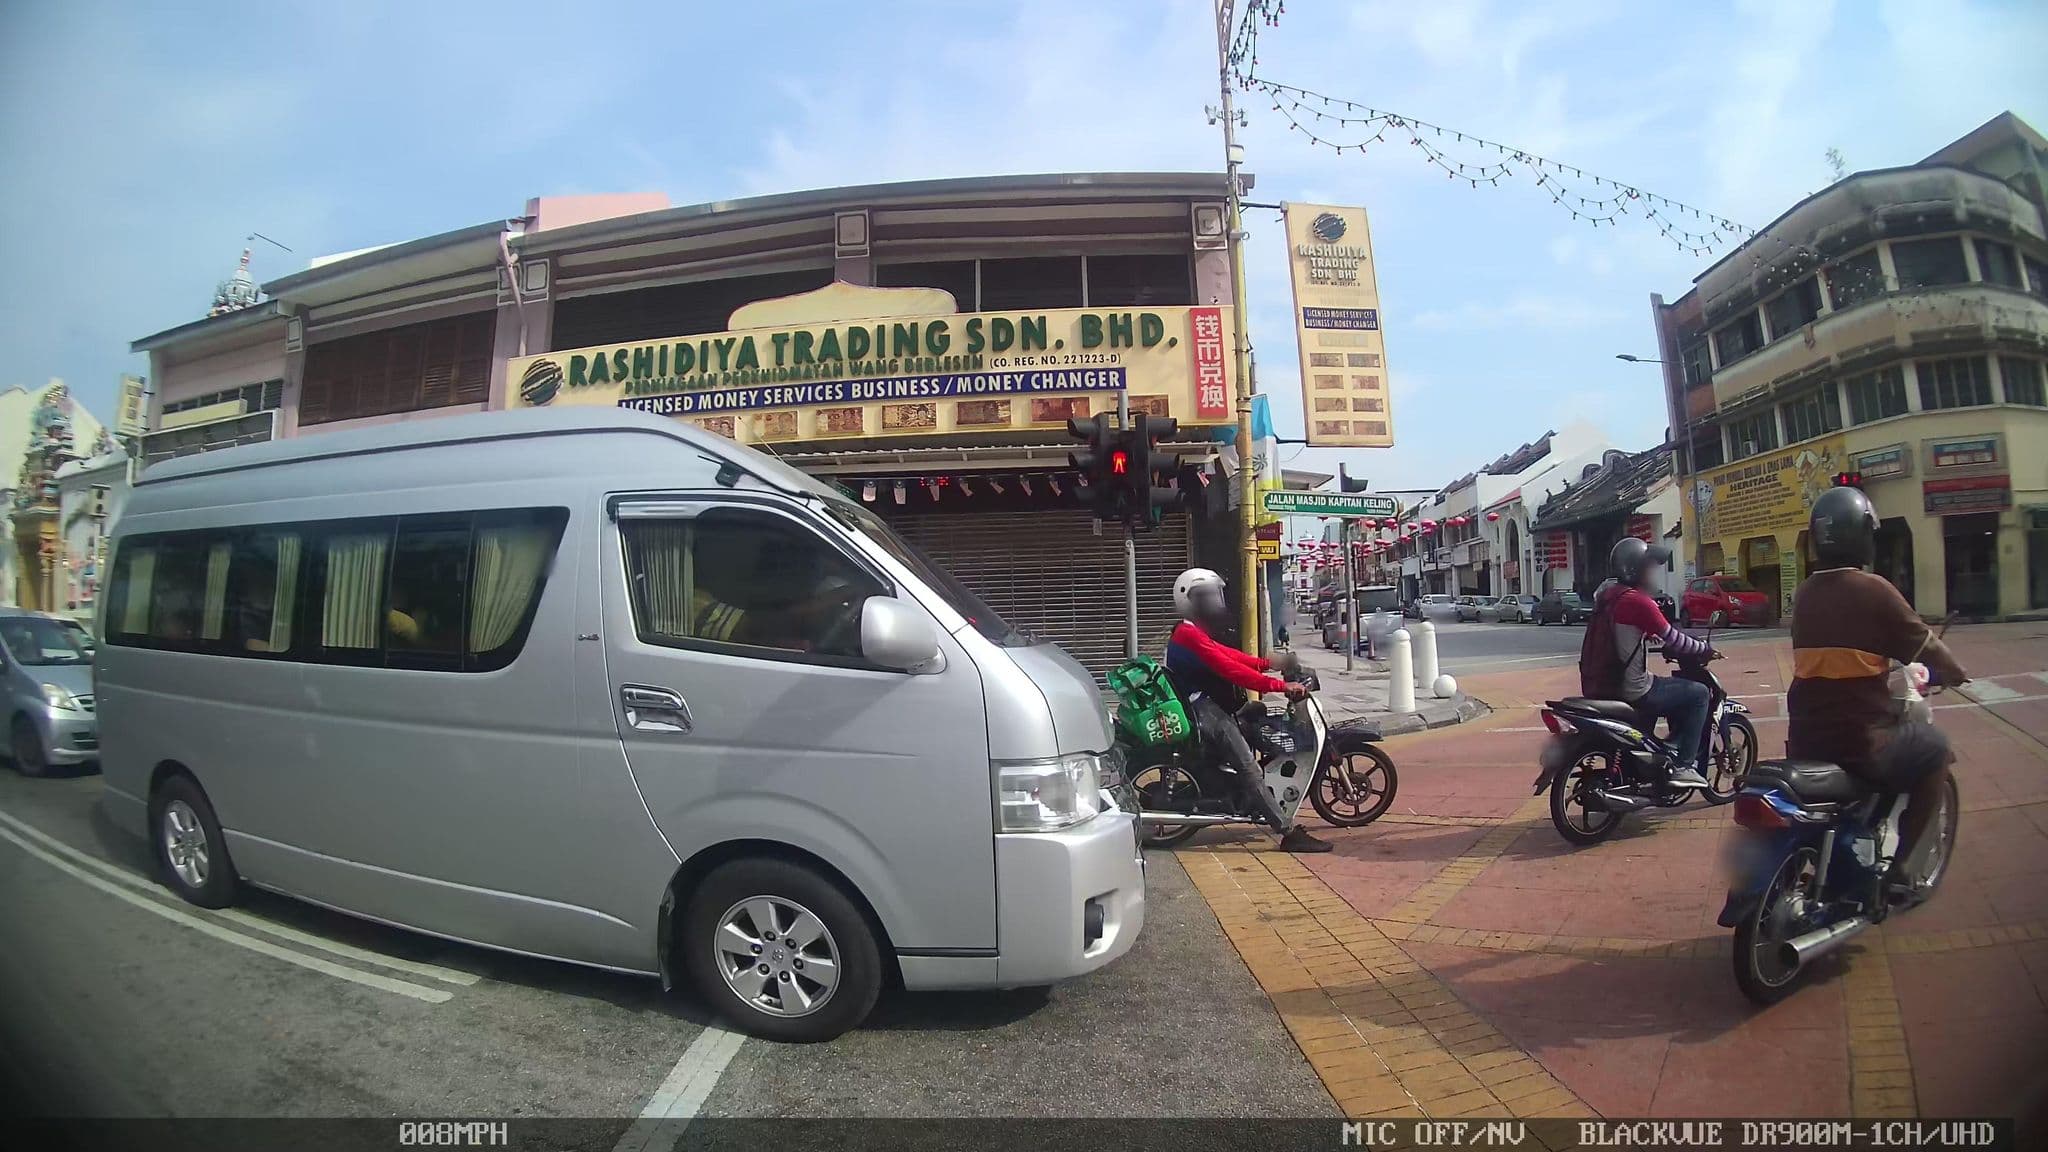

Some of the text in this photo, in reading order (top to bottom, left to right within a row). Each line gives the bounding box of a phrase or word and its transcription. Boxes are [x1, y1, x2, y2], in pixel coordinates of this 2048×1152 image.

[1311, 257, 1360, 269] TRADING
[570, 313, 1178, 386] RASHIDIYA TRADING SDN. BHD.
[850, 358, 899, 376] WANG
[905, 355, 984, 373] BERLESEN
[1015, 356, 1039, 366] REG.
[1041, 355, 1061, 365] NO.
[1196, 314, 1225, 408] 钱币兑换
[698, 390, 759, 410] MONEY
[763, 383, 844, 405] SERVICES
[1030, 371, 1121, 390] CHANGER
[1730, 473, 1779, 492] HERITAGE
[1268, 494, 1392, 509] JALAN MASJID KAPITAN KELING
